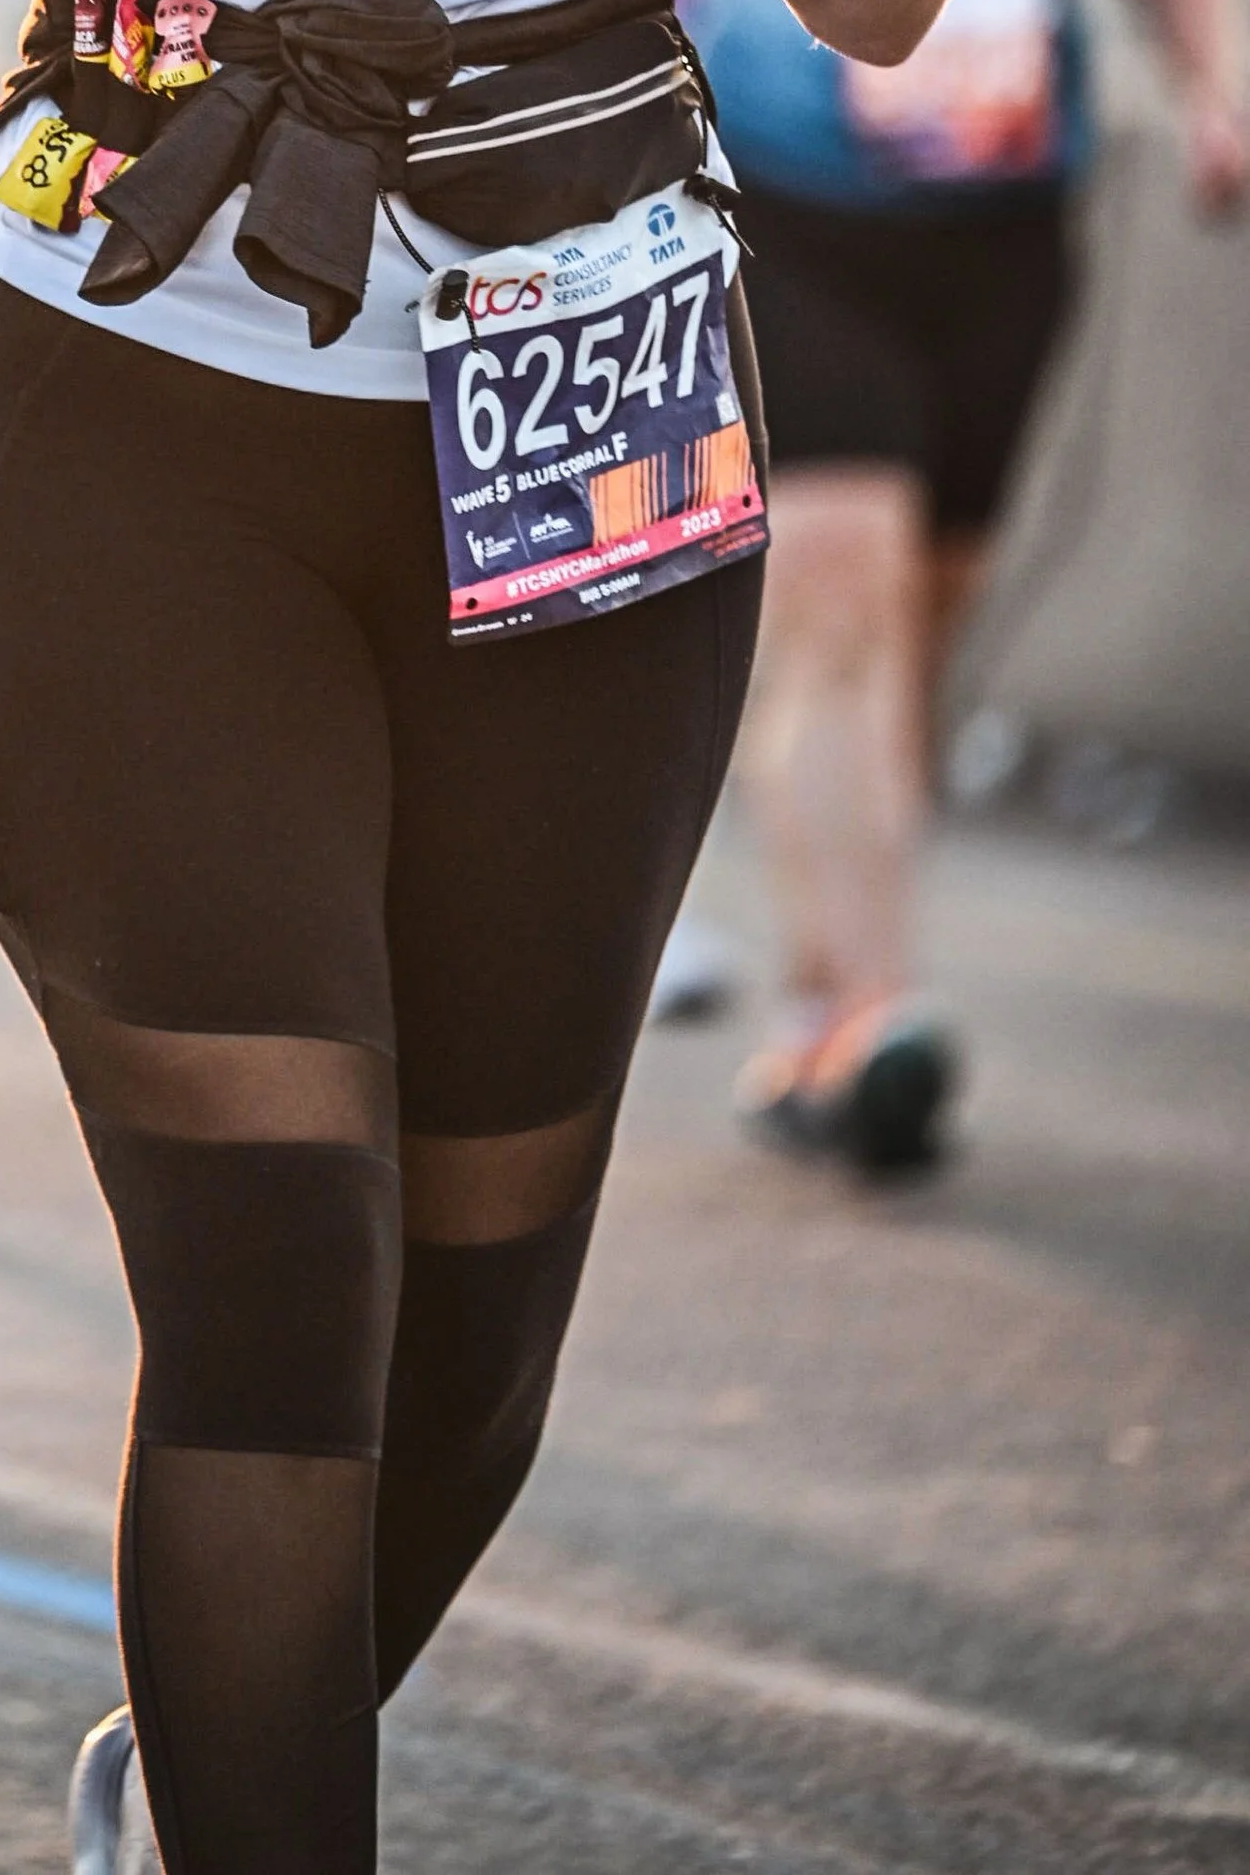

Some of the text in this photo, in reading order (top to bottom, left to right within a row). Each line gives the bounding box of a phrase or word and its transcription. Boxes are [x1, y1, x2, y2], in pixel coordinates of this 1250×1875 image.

[158, 70, 186, 85] PLUS
[553, 246, 585, 267] TATA
[553, 242, 632, 287] CONSULTANCY
[649, 236, 685, 265] TATA
[552, 275, 612, 306] SERVICES
[457, 271, 710, 471] 62547
[680, 507, 722, 538] 2023
